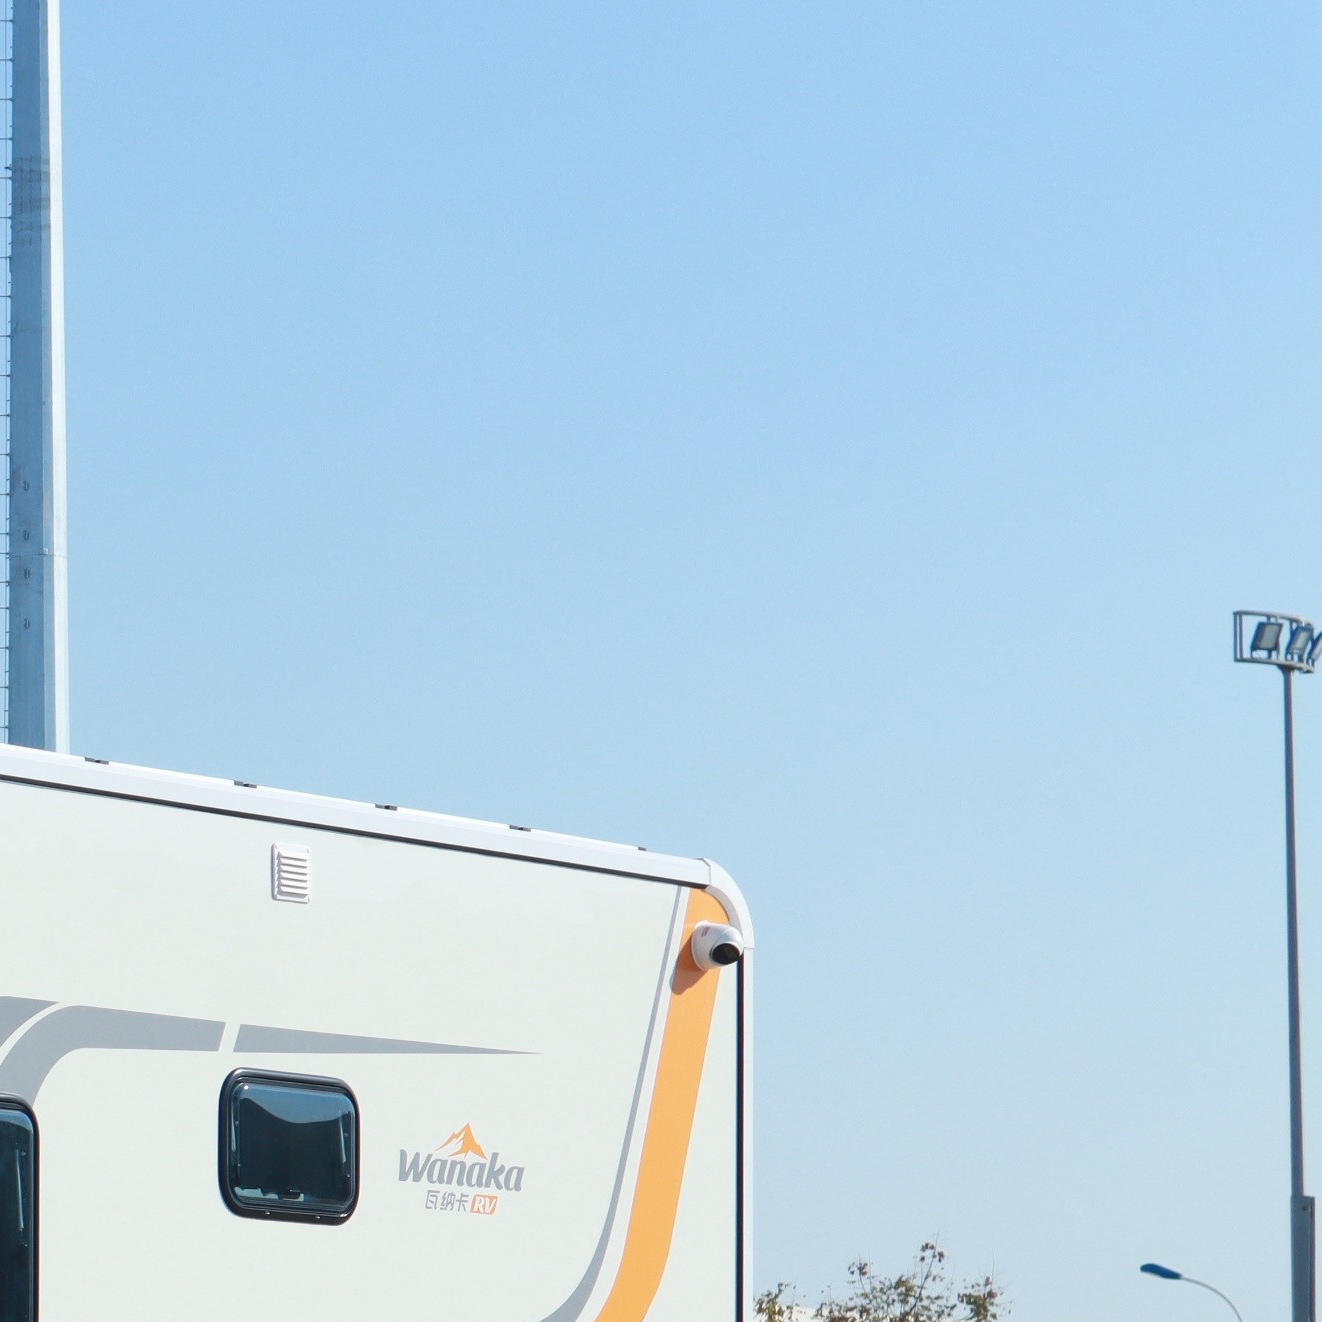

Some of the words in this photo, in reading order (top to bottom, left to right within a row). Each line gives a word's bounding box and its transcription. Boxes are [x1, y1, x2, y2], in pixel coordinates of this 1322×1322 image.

[398, 1149, 525, 1192] Wanaka
[425, 1189, 470, 1213] 瓦纳卡
[472, 1195, 497, 1213] RV
